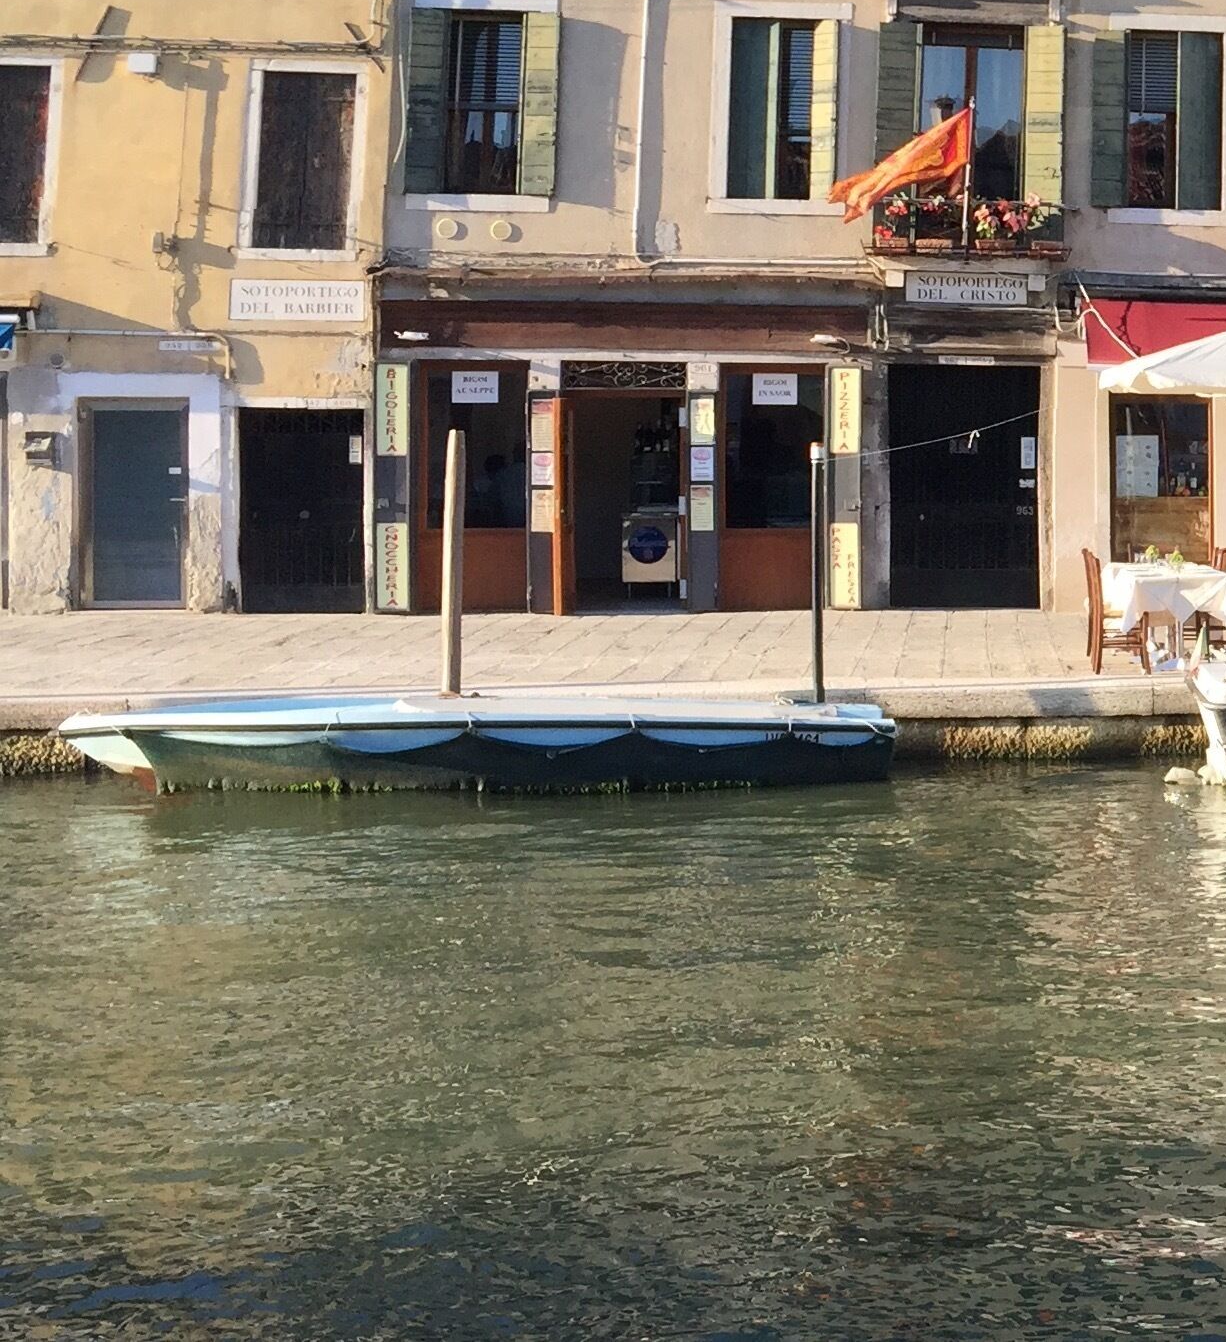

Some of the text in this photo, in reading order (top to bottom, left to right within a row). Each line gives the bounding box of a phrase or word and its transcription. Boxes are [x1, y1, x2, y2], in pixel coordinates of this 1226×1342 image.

[918, 275, 1024, 289] SOTOPORTEGO
[240, 284, 359, 298] SOTOPORTEGO
[917, 288, 1017, 302] DEL CRISTO
[239, 301, 354, 315] DEL BARBIER
[384, 367, 398, 453] BIGOLERIA
[839, 371, 850, 451] PIZZERIA
[1015, 505, 1035, 516] 963
